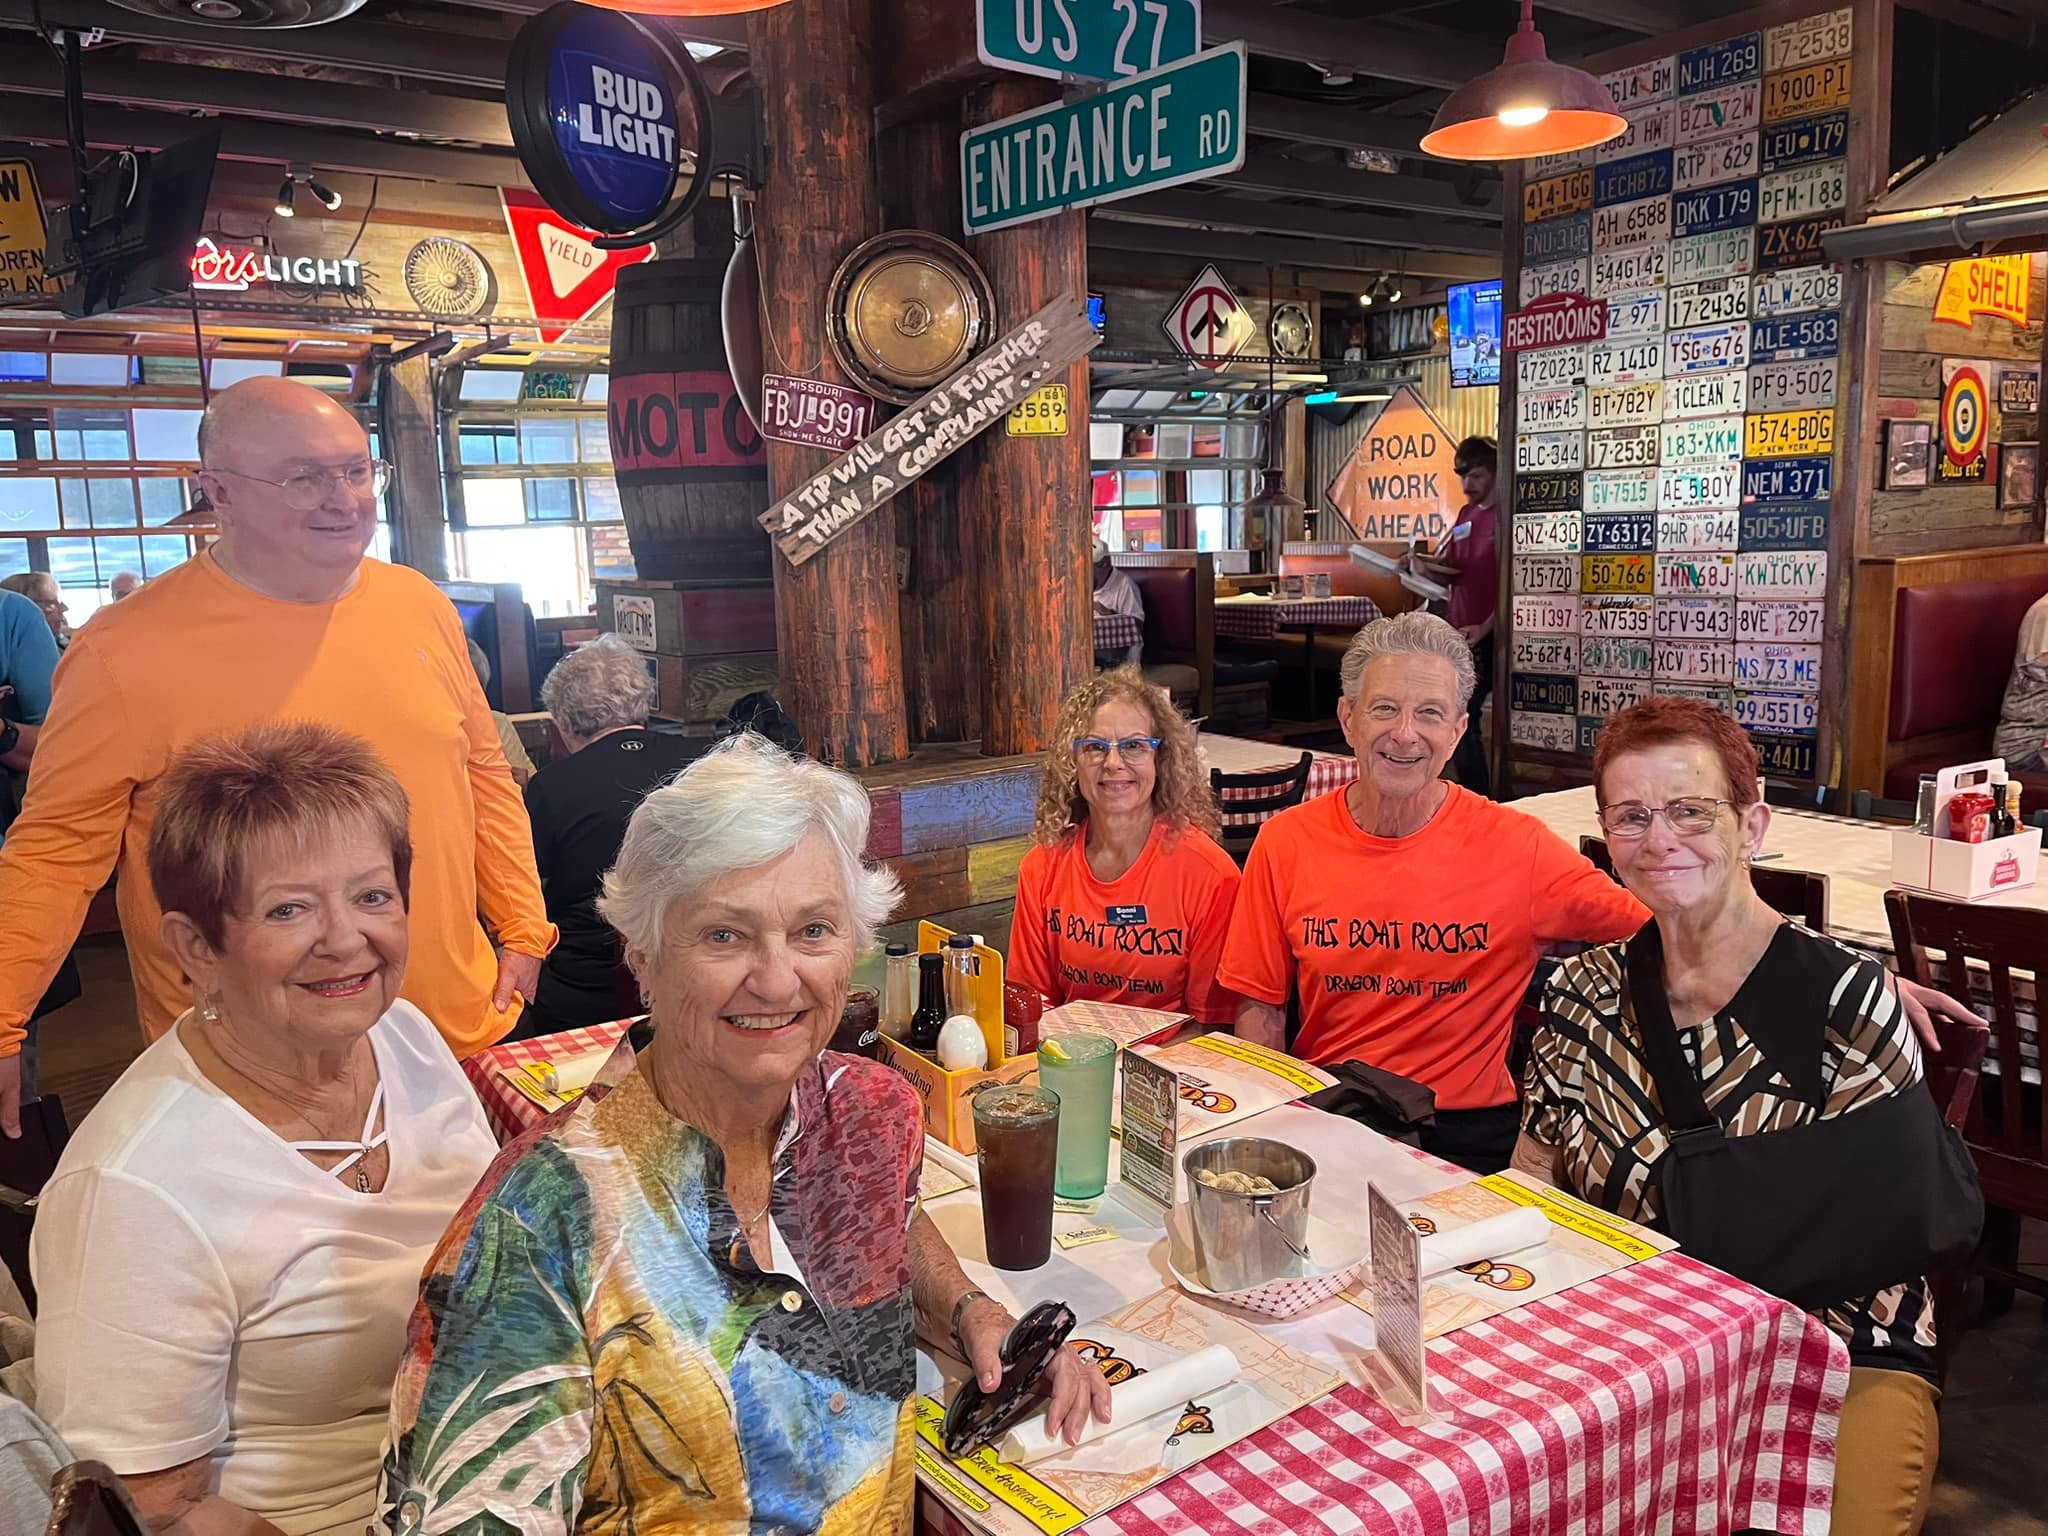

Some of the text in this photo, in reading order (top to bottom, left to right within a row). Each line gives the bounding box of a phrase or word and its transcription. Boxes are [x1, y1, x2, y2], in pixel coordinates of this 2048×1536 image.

[1016, 0, 1168, 75] US 27
[1653, 67, 1671, 93] BM
[1681, 61, 1714, 88] NJH
[1722, 46, 1756, 74] 269
[591, 65, 664, 120] BUD
[578, 103, 676, 164] LIGHT
[1765, 132, 1796, 160] LEU
[1813, 122, 1844, 152] 179
[970, 83, 1231, 218] ENTRANCE RD
[1677, 153, 1706, 182] RTP
[1723, 143, 1753, 171] 629
[1784, 168, 1823, 183] TEXAS
[1597, 202, 1667, 236] AH 6588
[1677, 188, 1751, 227] DKK 179
[1615, 232, 1647, 245] UTAH
[1690, 233, 1736, 246] GEORGIA
[550, 236, 593, 269] YIELD
[1672, 241, 1749, 275] PPM 130
[263, 255, 359, 287] LIGHT
[1968, 262, 2024, 313] SHELL
[1506, 304, 1601, 348] RESTROOMS
[1631, 301, 1659, 325] 971
[1536, 348, 1569, 359] INDIANA
[1592, 346, 1658, 375] RZ 1410
[1671, 336, 1744, 363] TSG 676
[1520, 356, 1584, 383] 472023A
[789, 380, 842, 398] MISSOURI
[1676, 382, 1723, 410] 1CLEAN
[781, 502, 805, 532] A
[798, 474, 831, 510] TIP
[882, 410, 927, 454] GET
[927, 389, 952, 417] U
[949, 320, 1051, 400] FURTHER
[1688, 421, 1716, 431] OHIO
[1750, 416, 1831, 444] 1574-BDG
[815, 434, 842, 448] STATE
[1370, 433, 1437, 462] ROAD
[1766, 443, 1808, 453] NEW YORK
[1774, 461, 1798, 469] IOWA
[1367, 472, 1440, 501] WORK
[1663, 475, 1733, 500] AE 580Y
[1747, 469, 1825, 495] NEM 371
[798, 487, 863, 544] THAN
[870, 474, 895, 503] A
[1363, 513, 1444, 540] AHEAD
[1661, 520, 1734, 544] 9HR 944
[1767, 554, 1796, 564] OHIO
[1697, 565, 1730, 587] 68J
[1745, 562, 1817, 586] KWICKY
[1679, 600, 1708, 609] Virginia
[1658, 610, 1729, 633] CFV-943
[1740, 609, 1820, 633] 8VE 297
[1657, 650, 1727, 675] XCV 511
[1764, 645, 1793, 657] OHIO
[1737, 657, 1818, 682] NS 73 ME
[1655, 689, 1706, 697] WASHINGTON
[1753, 725, 1795, 734] INDIANA
[1066, 913, 1183, 956] BOAT ROCKS!
[1303, 917, 1489, 954] THIS BOAT ROCKS!
[1093, 971, 1123, 991] BOAT
[1127, 978, 1164, 994] TEAM
[1324, 973, 1468, 999] DRAGON BOAT TEAM
[966, 1450, 1000, 1475] SERVE
[995, 1473, 1067, 1520] HOSPITALITY!
